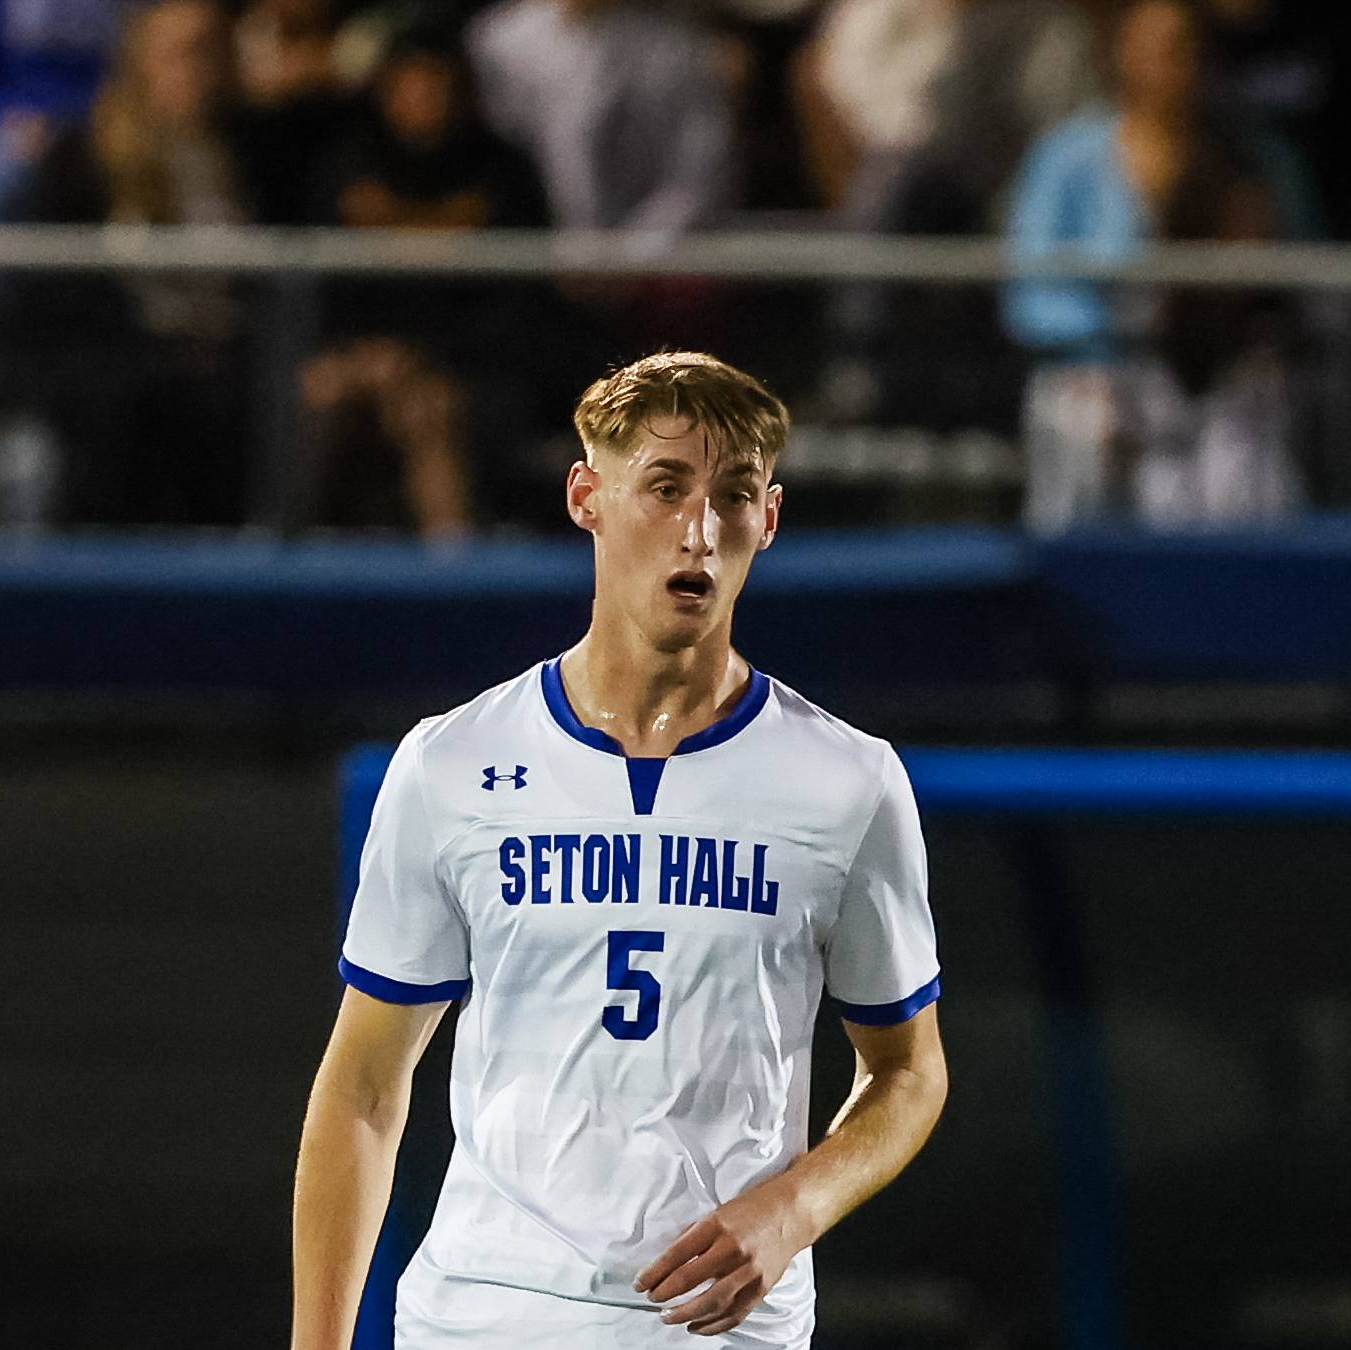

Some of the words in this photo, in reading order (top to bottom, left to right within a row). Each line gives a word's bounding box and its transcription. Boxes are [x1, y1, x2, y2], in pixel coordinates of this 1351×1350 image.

[499, 833, 641, 906] SETON
[659, 834, 780, 916] HALL
[601, 930, 665, 1041] 5
